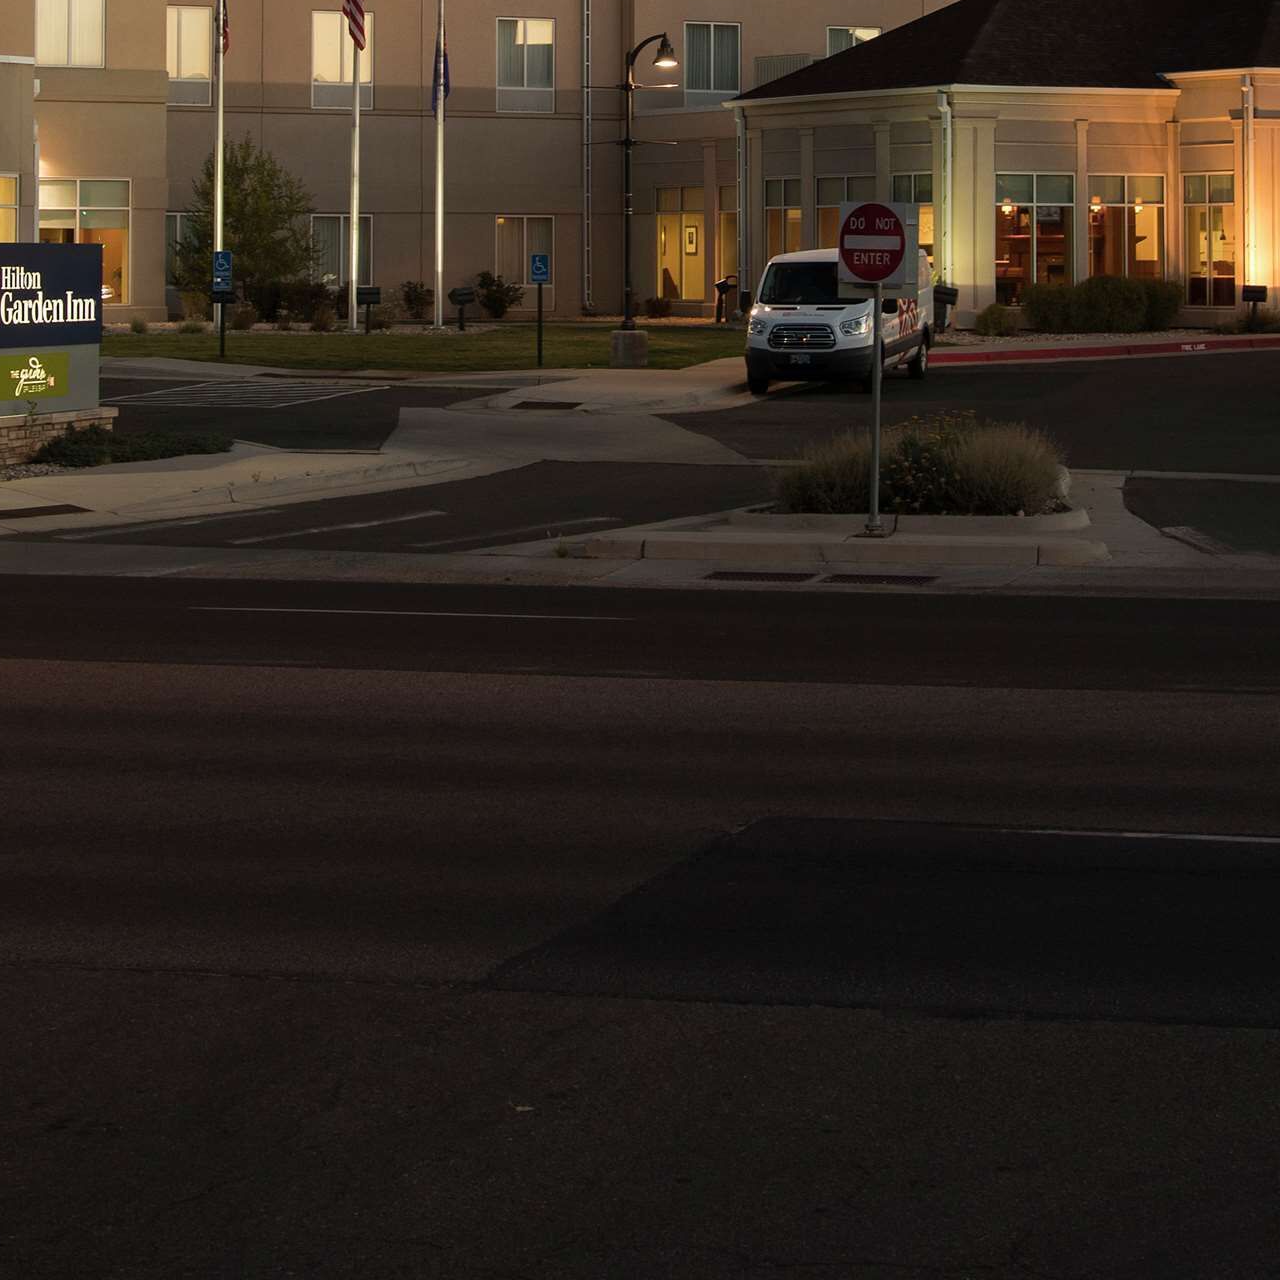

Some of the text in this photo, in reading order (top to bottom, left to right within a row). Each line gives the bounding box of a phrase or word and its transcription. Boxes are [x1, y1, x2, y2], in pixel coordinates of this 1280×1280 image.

[849, 216, 897, 231] DO NOT
[853, 252, 891, 265] ENTER
[0, 266, 42, 290] Hilton
[0, 290, 97, 326] Garden Inn
